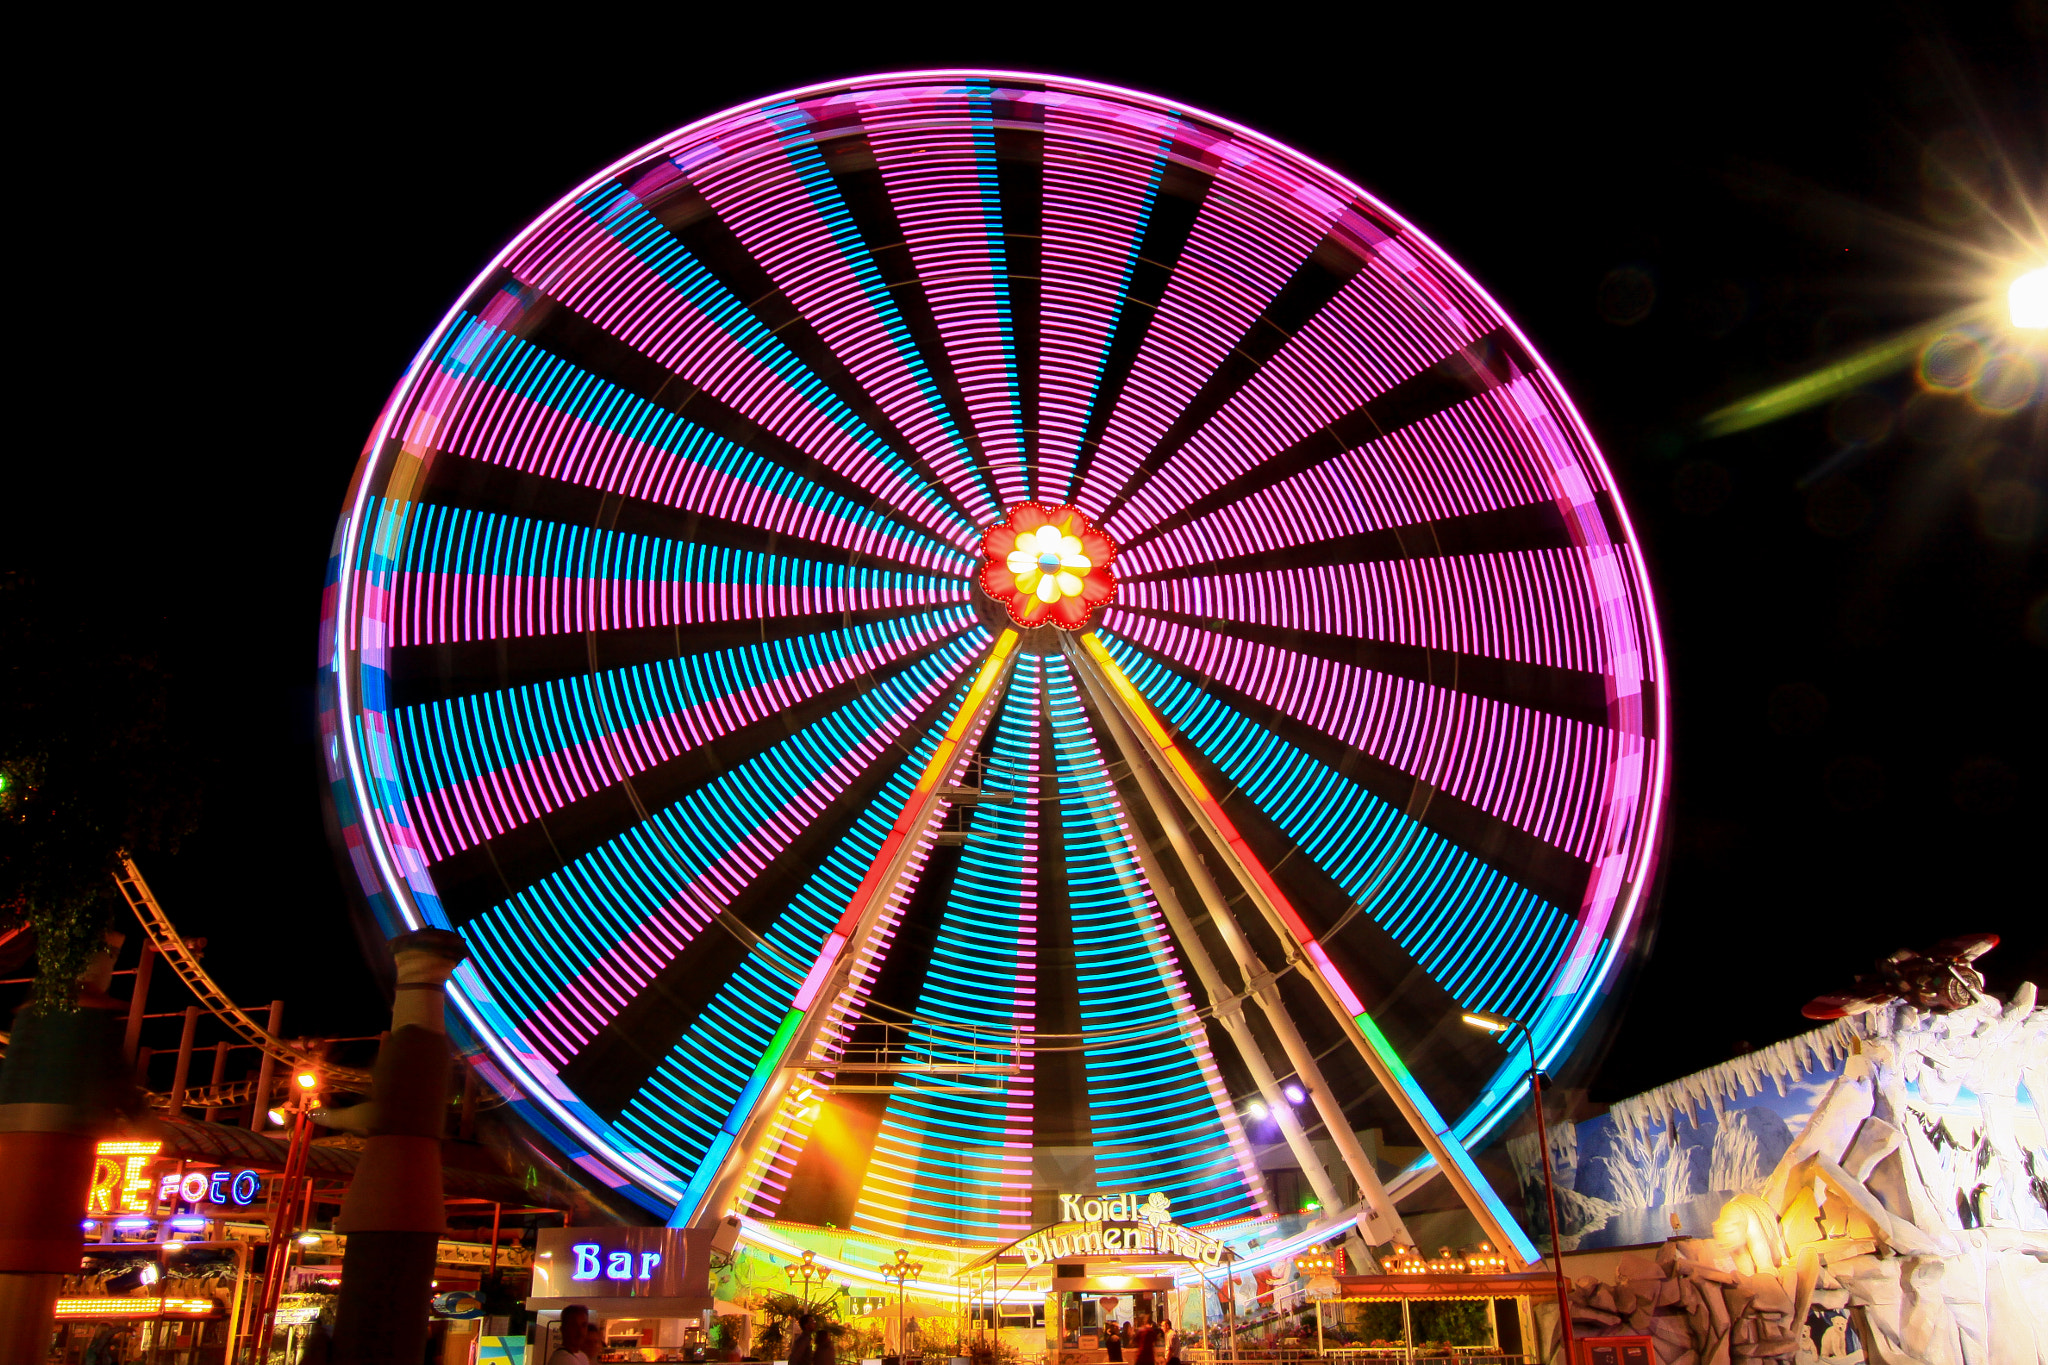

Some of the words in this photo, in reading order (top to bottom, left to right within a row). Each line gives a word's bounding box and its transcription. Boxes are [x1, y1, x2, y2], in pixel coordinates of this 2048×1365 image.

[158, 1169, 261, 1207] FOTO
[1059, 1193, 1138, 1222] Koidl
[571, 1243, 662, 1280] Bar
[1014, 1226, 1143, 1270] Blumen
[1159, 1222, 1225, 1267] Rad
